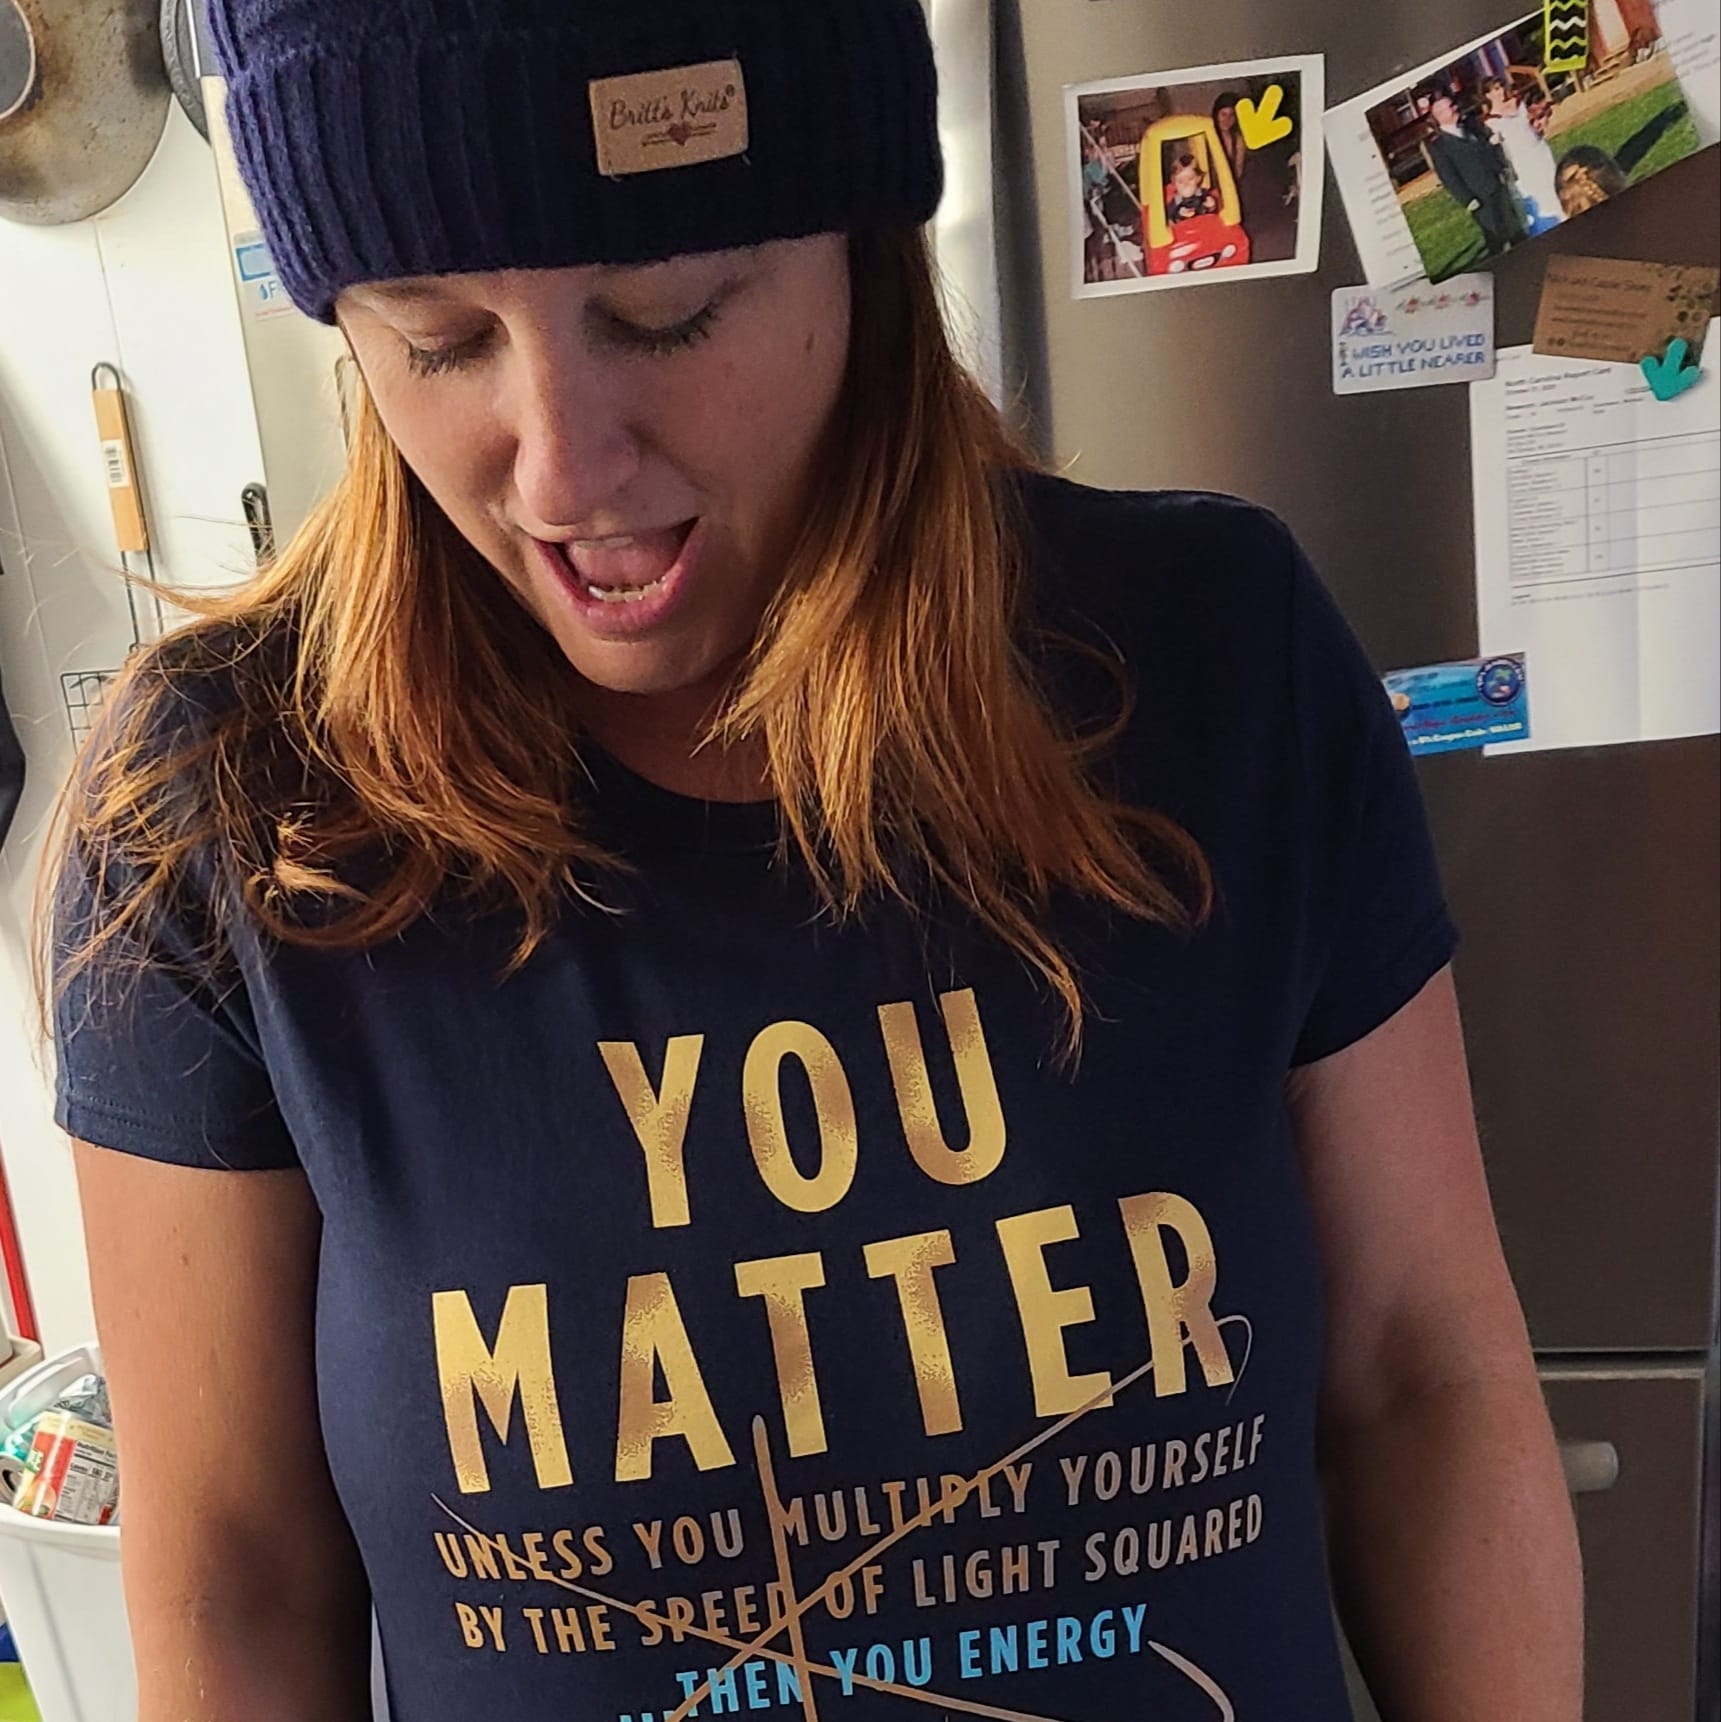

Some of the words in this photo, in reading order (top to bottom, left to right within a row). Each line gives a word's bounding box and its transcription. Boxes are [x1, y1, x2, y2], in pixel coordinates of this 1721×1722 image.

[1359, 358, 1416, 377] LITTLE
[1420, 351, 1486, 371] NEARER
[1395, 338, 1435, 355] YOU
[597, 987, 1006, 1228] YOU
[431, 1191, 1234, 1494] MATTER
[434, 1526, 613, 1580] UNLESS
[633, 1508, 744, 1569] YOU
[775, 1462, 1033, 1548] MULTIPLY
[1059, 1413, 1266, 1506] YOURSELF
[455, 1602, 507, 1652] BY
[522, 1604, 617, 1654] THE
[633, 1580, 800, 1646] SPEED
[823, 1565, 885, 1620] OF
[912, 1539, 1060, 1608] LIGHT
[1085, 1493, 1263, 1582] SQUARED
[829, 1637, 933, 1697] YOU
[958, 1603, 1147, 1679] ENERGY
